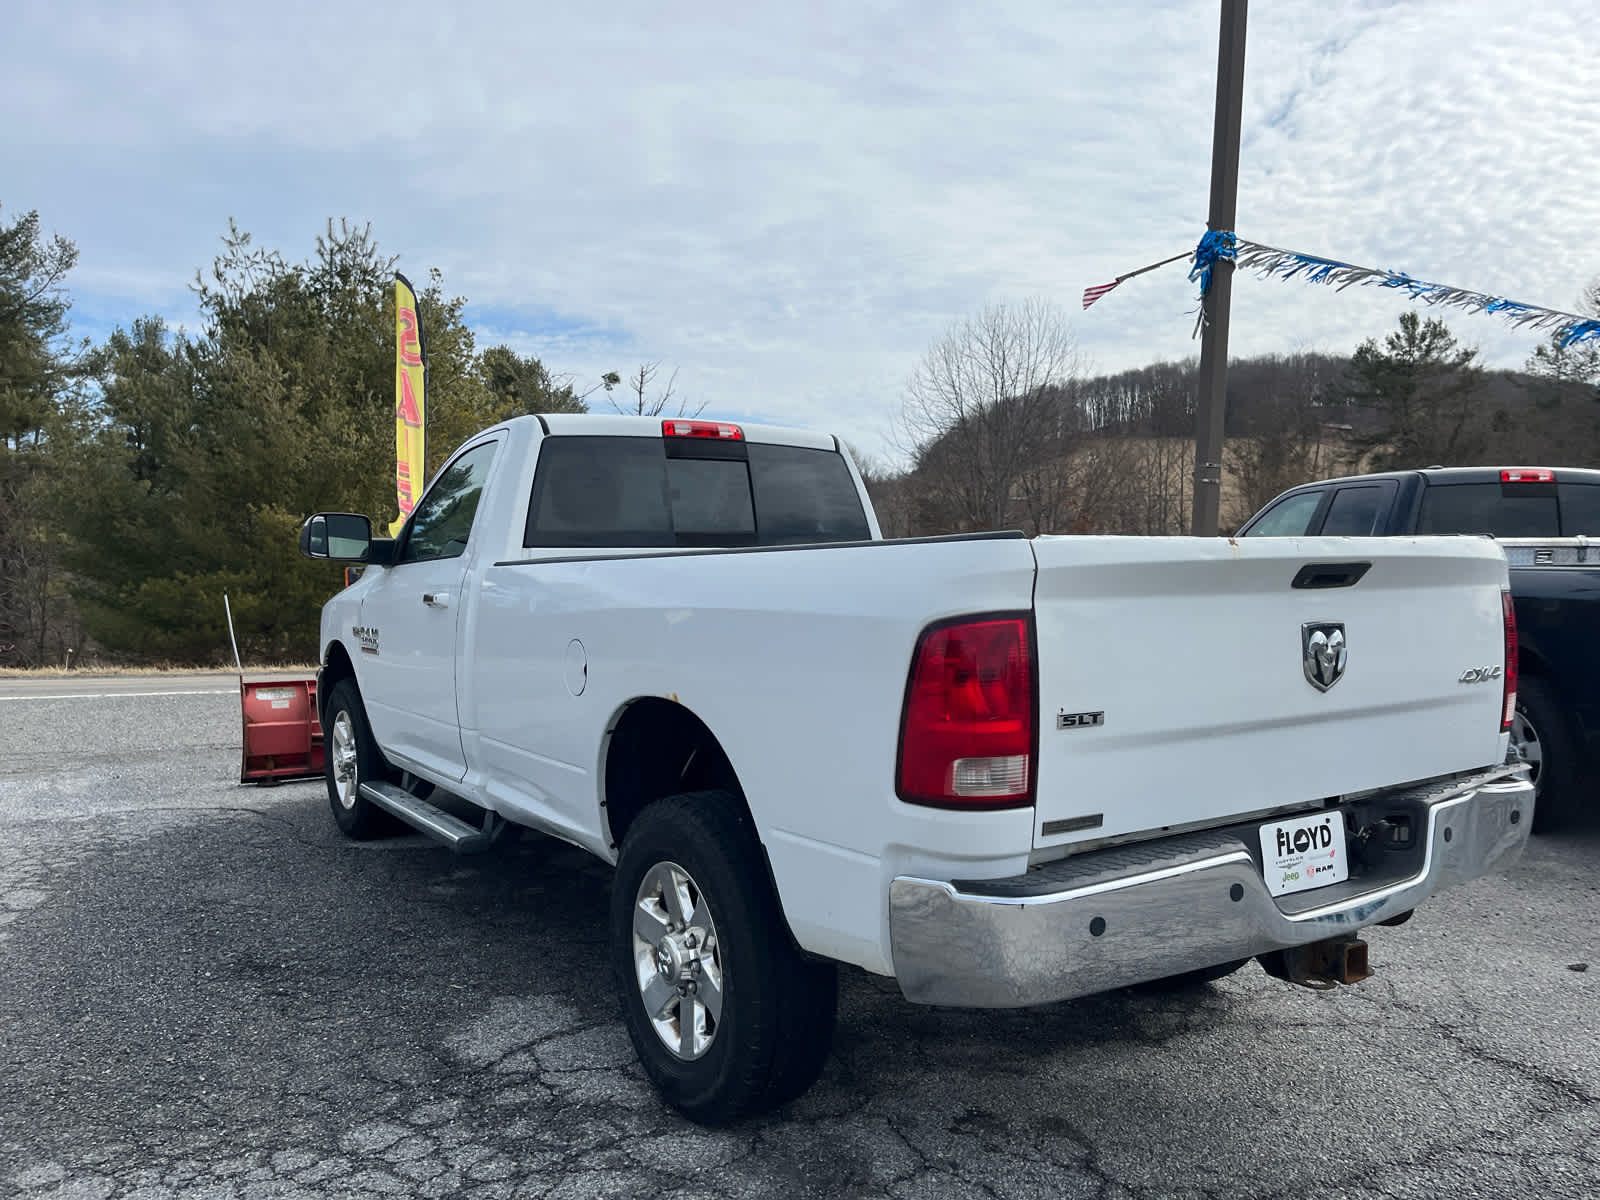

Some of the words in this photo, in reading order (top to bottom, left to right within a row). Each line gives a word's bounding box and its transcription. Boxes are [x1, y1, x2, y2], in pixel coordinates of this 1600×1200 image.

[1062, 713, 1102, 727] SLT
[1276, 824, 1332, 857] FLOYD
[1315, 864, 1334, 873] RAM
[1282, 871, 1300, 882] Jeep
